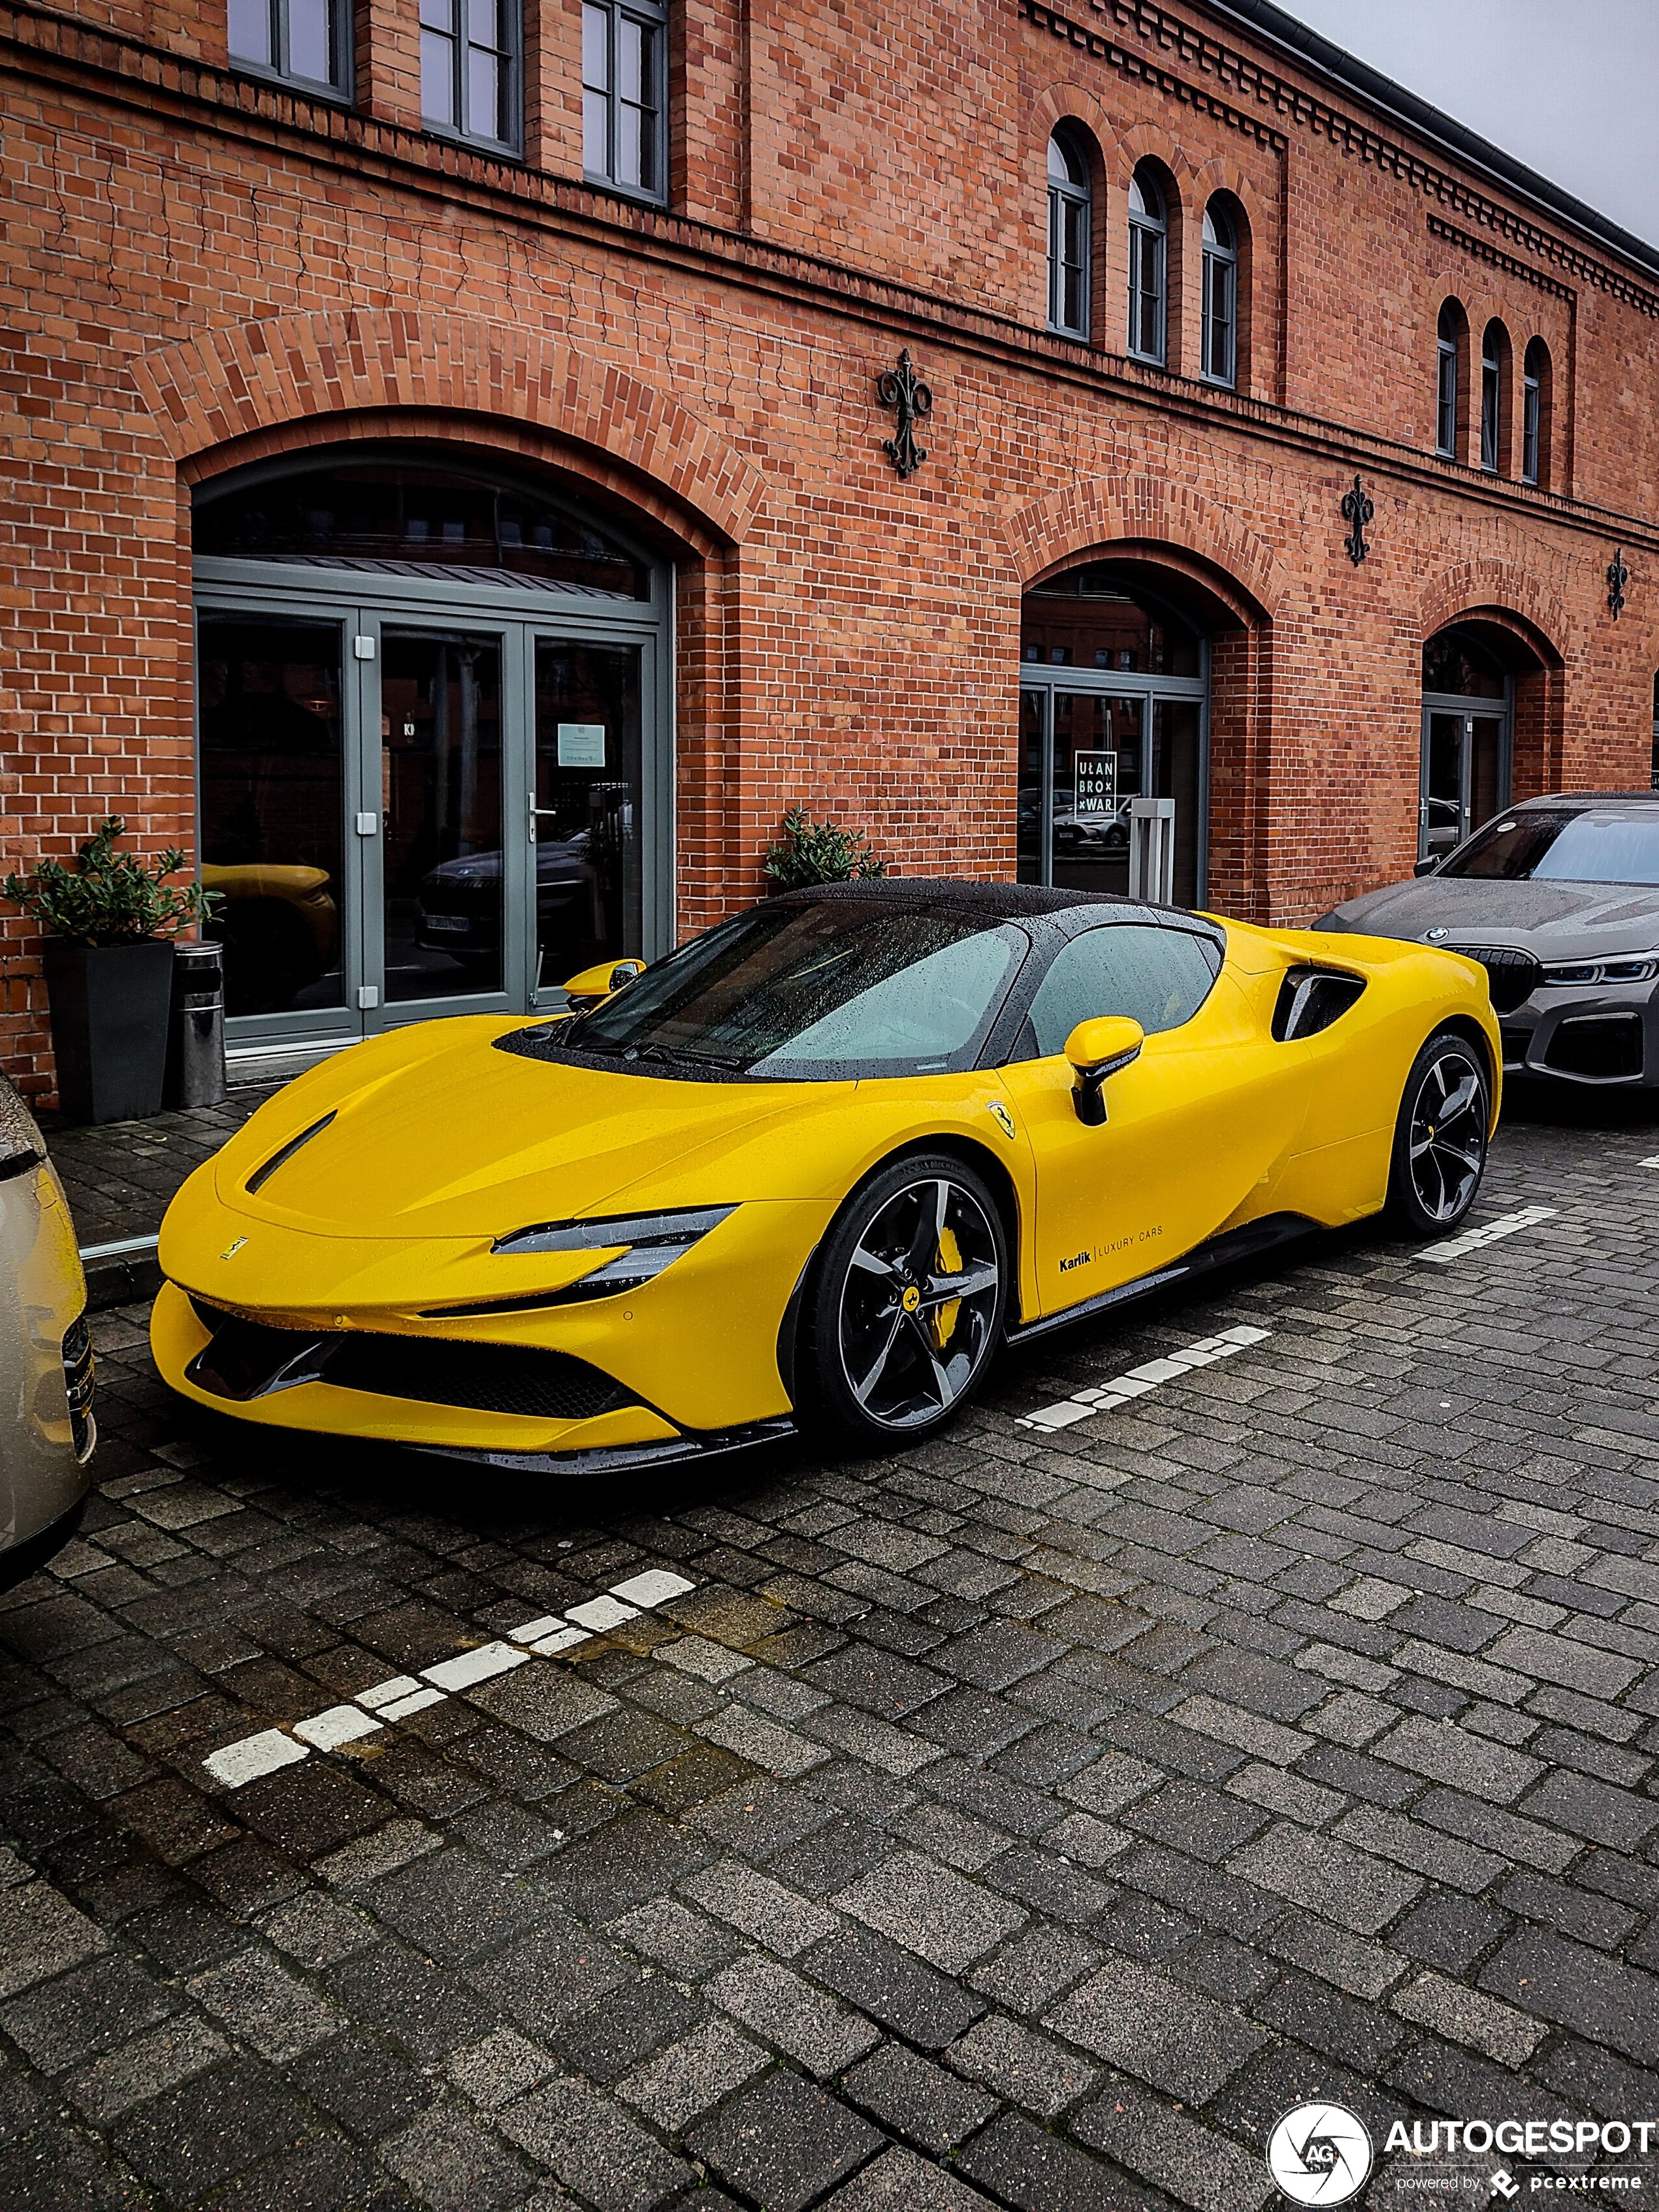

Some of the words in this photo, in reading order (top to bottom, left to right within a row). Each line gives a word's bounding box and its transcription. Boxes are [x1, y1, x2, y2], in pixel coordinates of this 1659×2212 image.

[1080, 762, 1112, 775] UŁAN
[1059, 1251, 1091, 1272] Karlik
[1099, 1236, 1135, 1257] LUXURY
[1139, 1225, 1163, 1242] CARS
